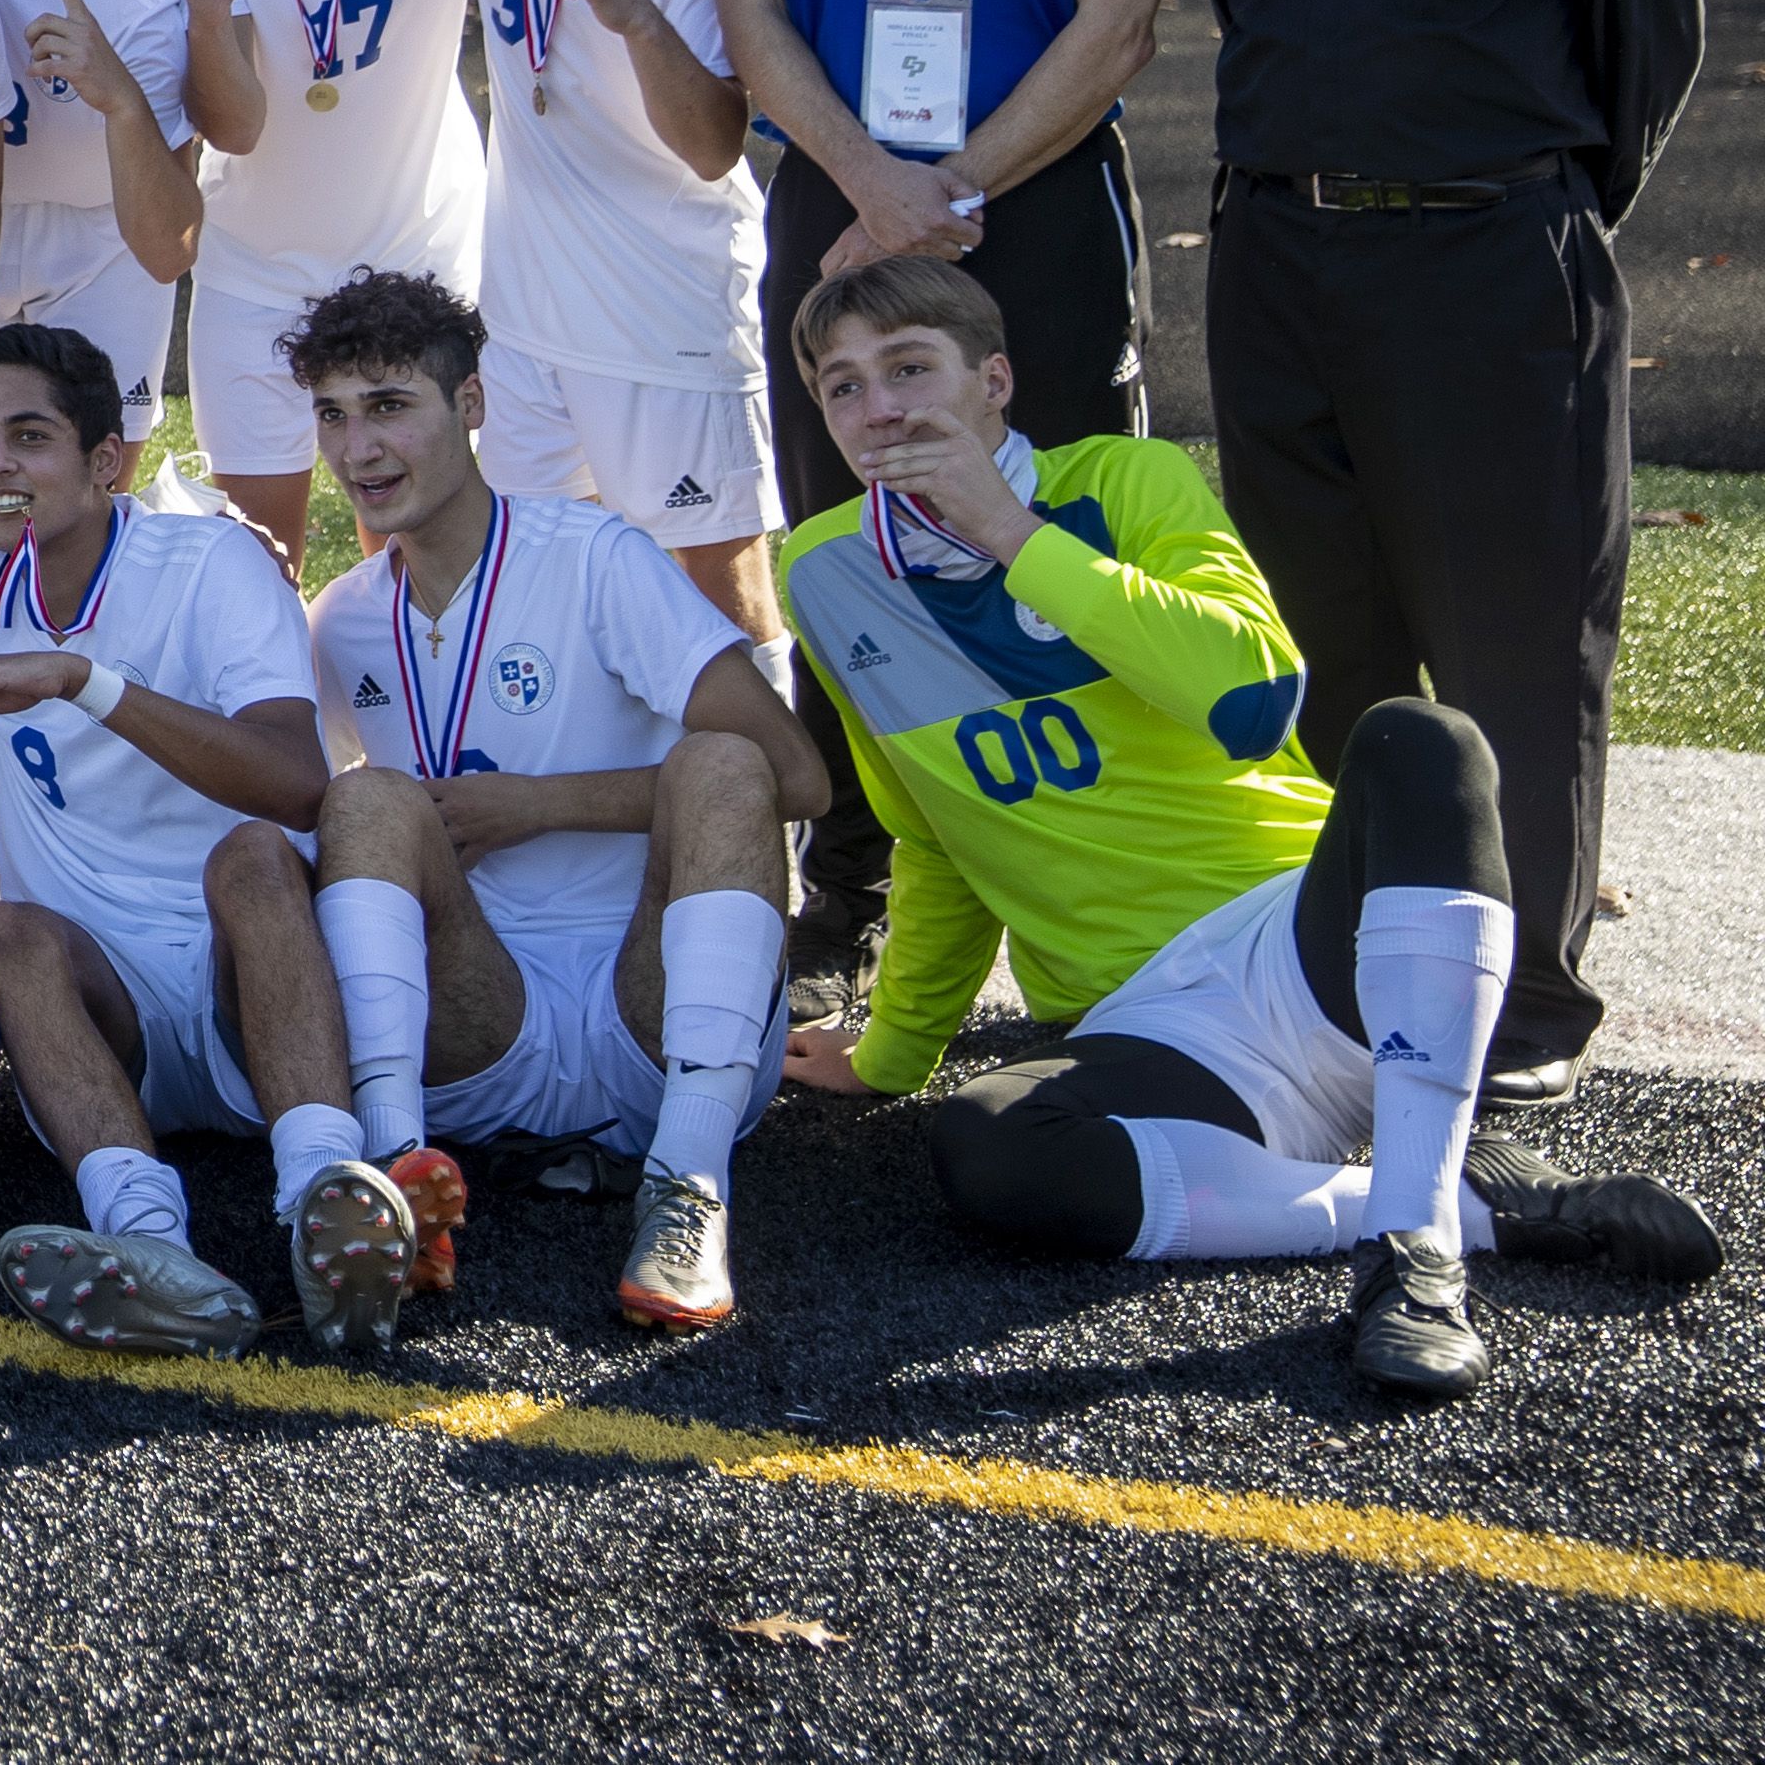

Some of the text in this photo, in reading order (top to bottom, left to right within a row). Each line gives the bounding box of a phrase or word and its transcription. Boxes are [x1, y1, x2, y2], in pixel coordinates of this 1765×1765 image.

[665, 492, 713, 510] adidas
[847, 652, 892, 672] adidas
[353, 694, 391, 709] adidas
[954, 699, 1101, 805] 00
